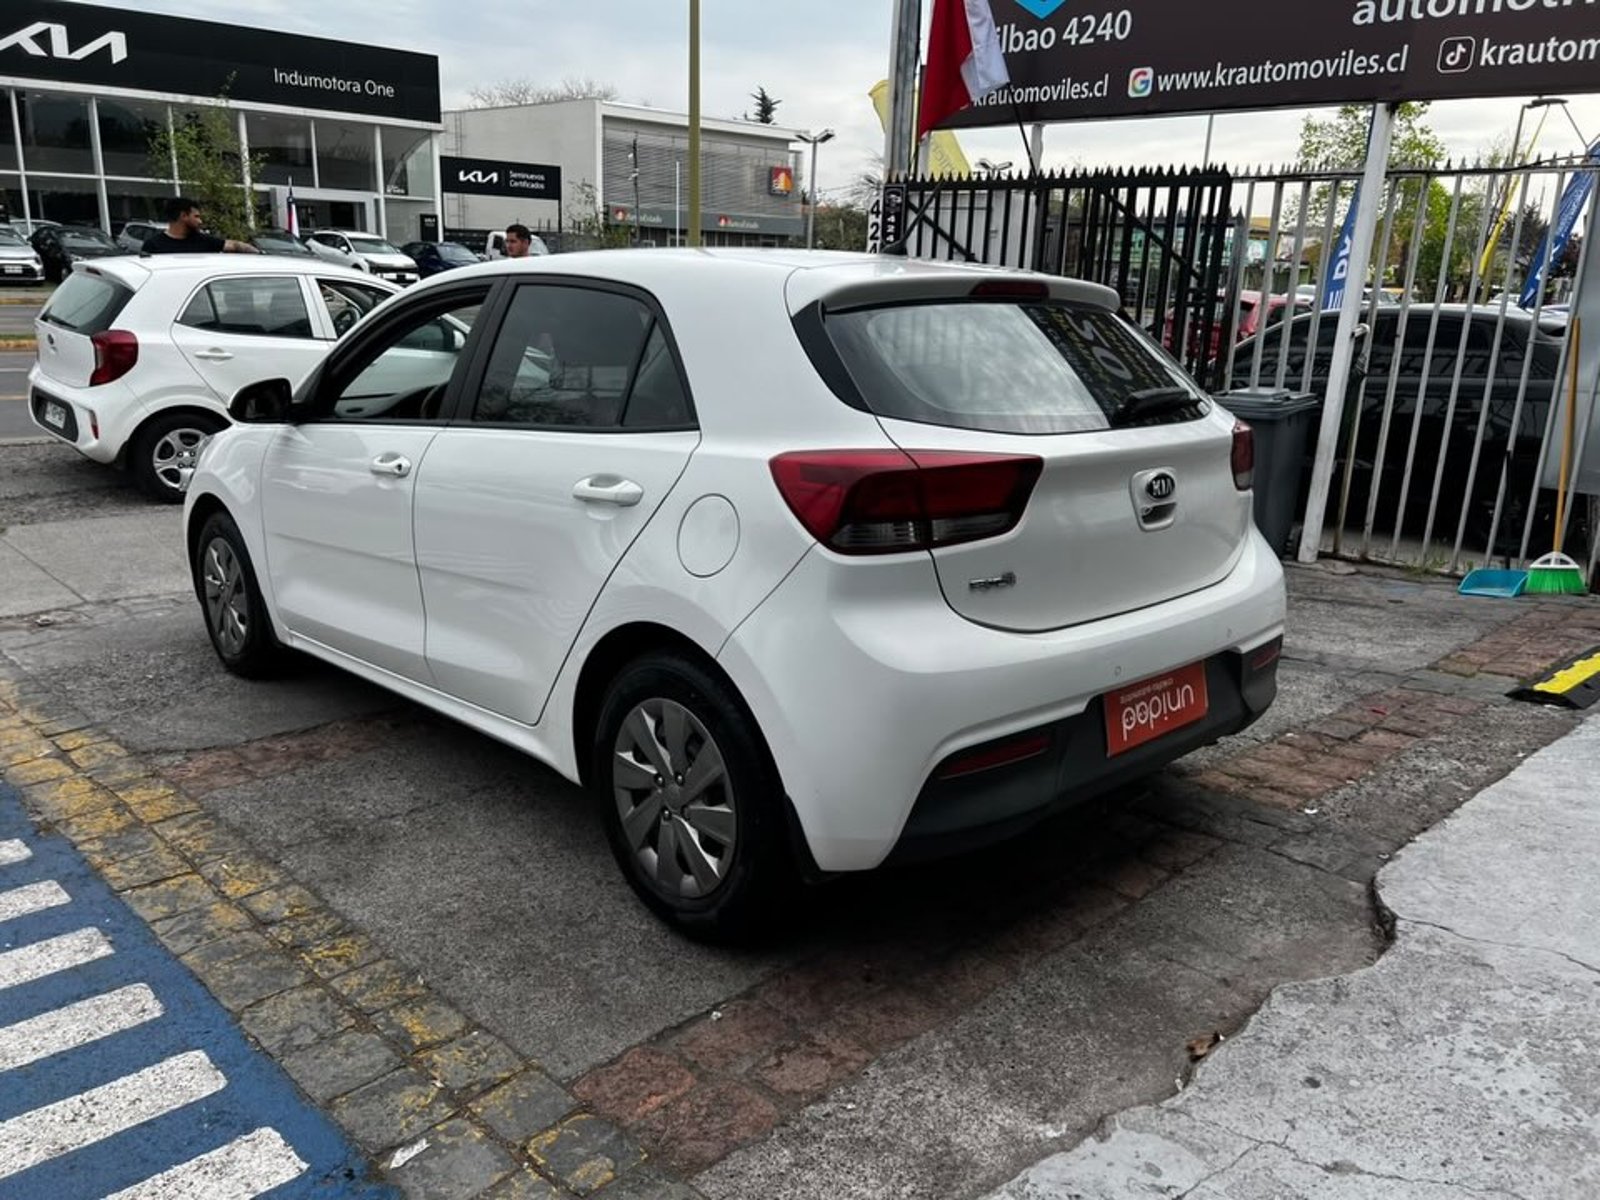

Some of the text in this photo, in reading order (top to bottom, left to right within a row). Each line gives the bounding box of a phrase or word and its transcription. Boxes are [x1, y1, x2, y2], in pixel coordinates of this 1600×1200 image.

[1062, 9, 1132, 46] 4240
[1352, 0, 1596, 25] autom
[1480, 35, 1600, 66] krautom
[273, 67, 395, 97] Indumotora One
[1157, 44, 1409, 92] www.krautomoviles.cl
[458, 170, 499, 184] KIA
[1150, 477, 1174, 498] KIA
[1121, 684, 1195, 741] unidad
